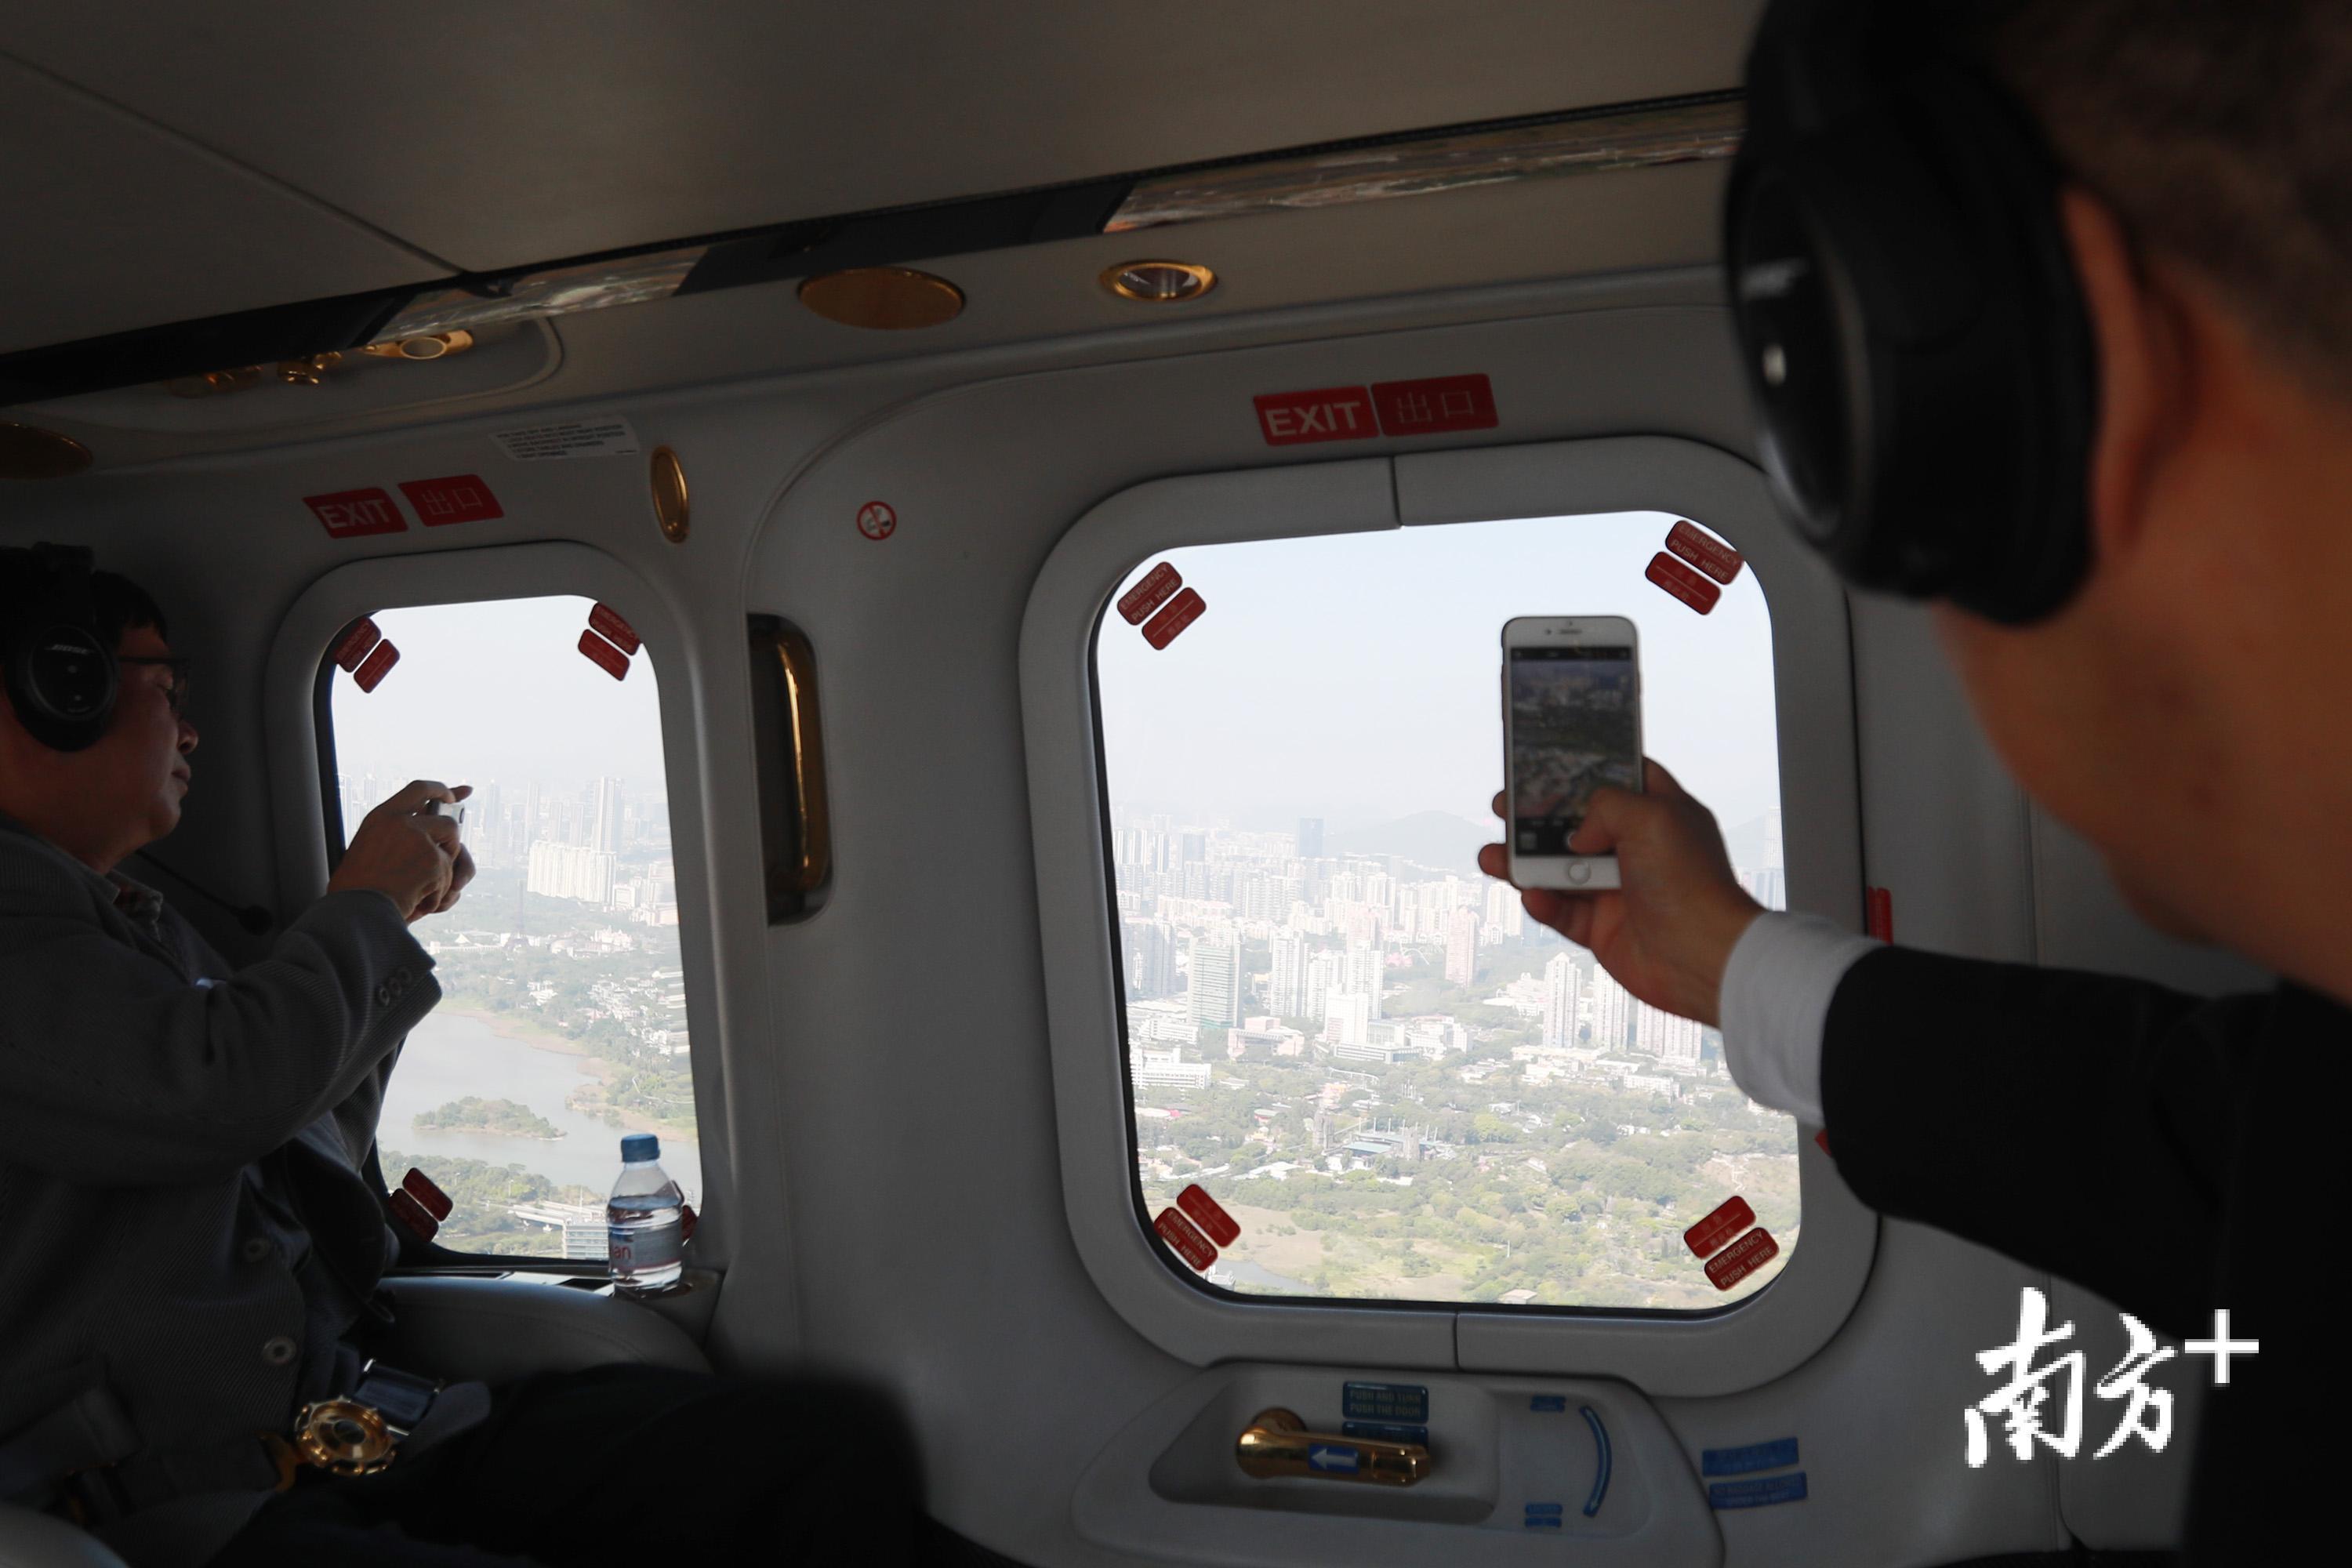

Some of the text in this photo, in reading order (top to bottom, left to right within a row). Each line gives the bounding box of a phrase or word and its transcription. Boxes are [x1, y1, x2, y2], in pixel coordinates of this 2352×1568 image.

[1265, 401, 1361, 437] EXIT
[1396, 390, 1475, 424] 出口
[317, 499, 390, 529] EXIT
[421, 487, 484, 516] 出口
[1671, 539, 1730, 580] PUSH HERE
[1679, 524, 1740, 567] EMERGENCY
[1120, 564, 1170, 609] EMERGENCY
[1131, 600, 1156, 622] PUSH
[1155, 579, 1178, 601] HERE
[1158, 1222, 1203, 1268] PUSH HERE
[1167, 1210, 1215, 1258] EMERGENCY
[1708, 1230, 1764, 1274] EMERGENCY
[1719, 1246, 1775, 1287] PUSH HERE
